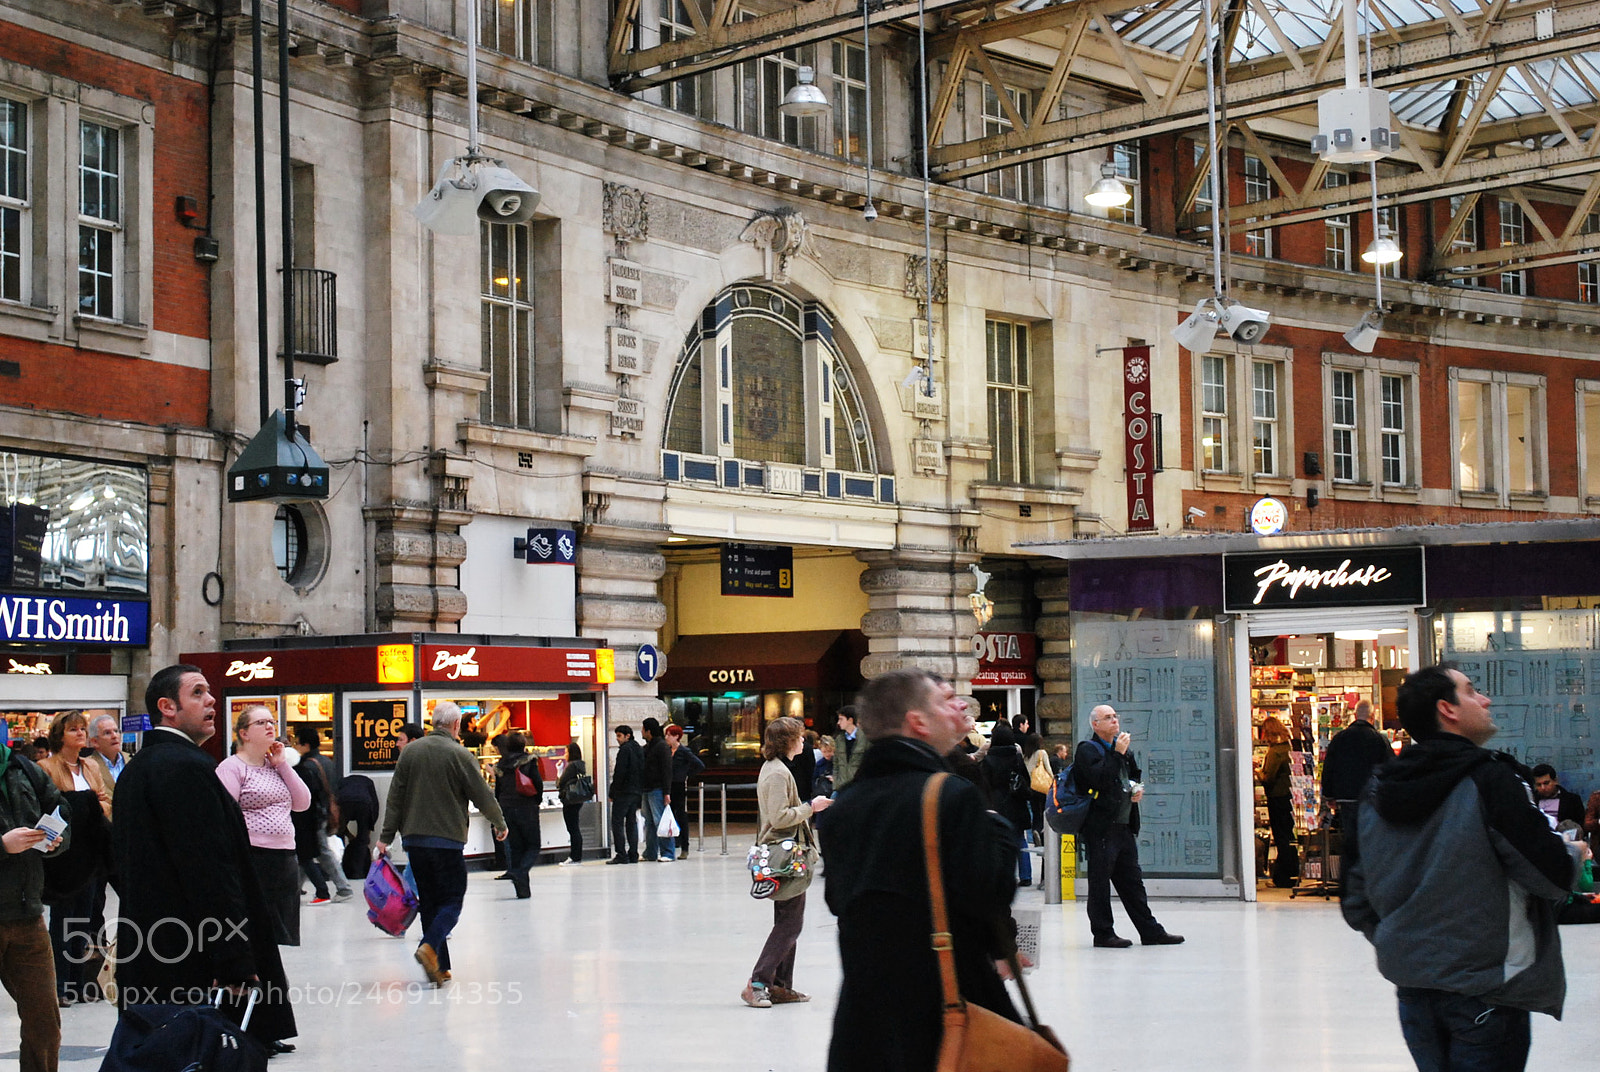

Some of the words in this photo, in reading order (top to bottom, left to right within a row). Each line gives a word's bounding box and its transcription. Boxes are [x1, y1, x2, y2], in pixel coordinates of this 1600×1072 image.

[1128, 391, 1150, 521] COSTA
[773, 469, 800, 491] EXIT
[1253, 514, 1281, 526] KING
[781, 571, 788, 586] 3
[1252, 558, 1392, 605] Paperchase
[379, 648, 407, 657] coffee
[971, 633, 1022, 663] OSTA
[708, 669, 755, 684] COSTA
[1001, 669, 1027, 683] upstairs
[354, 712, 405, 738] free
[364, 737, 396, 749] coffee
[368, 748, 391, 759] refill
